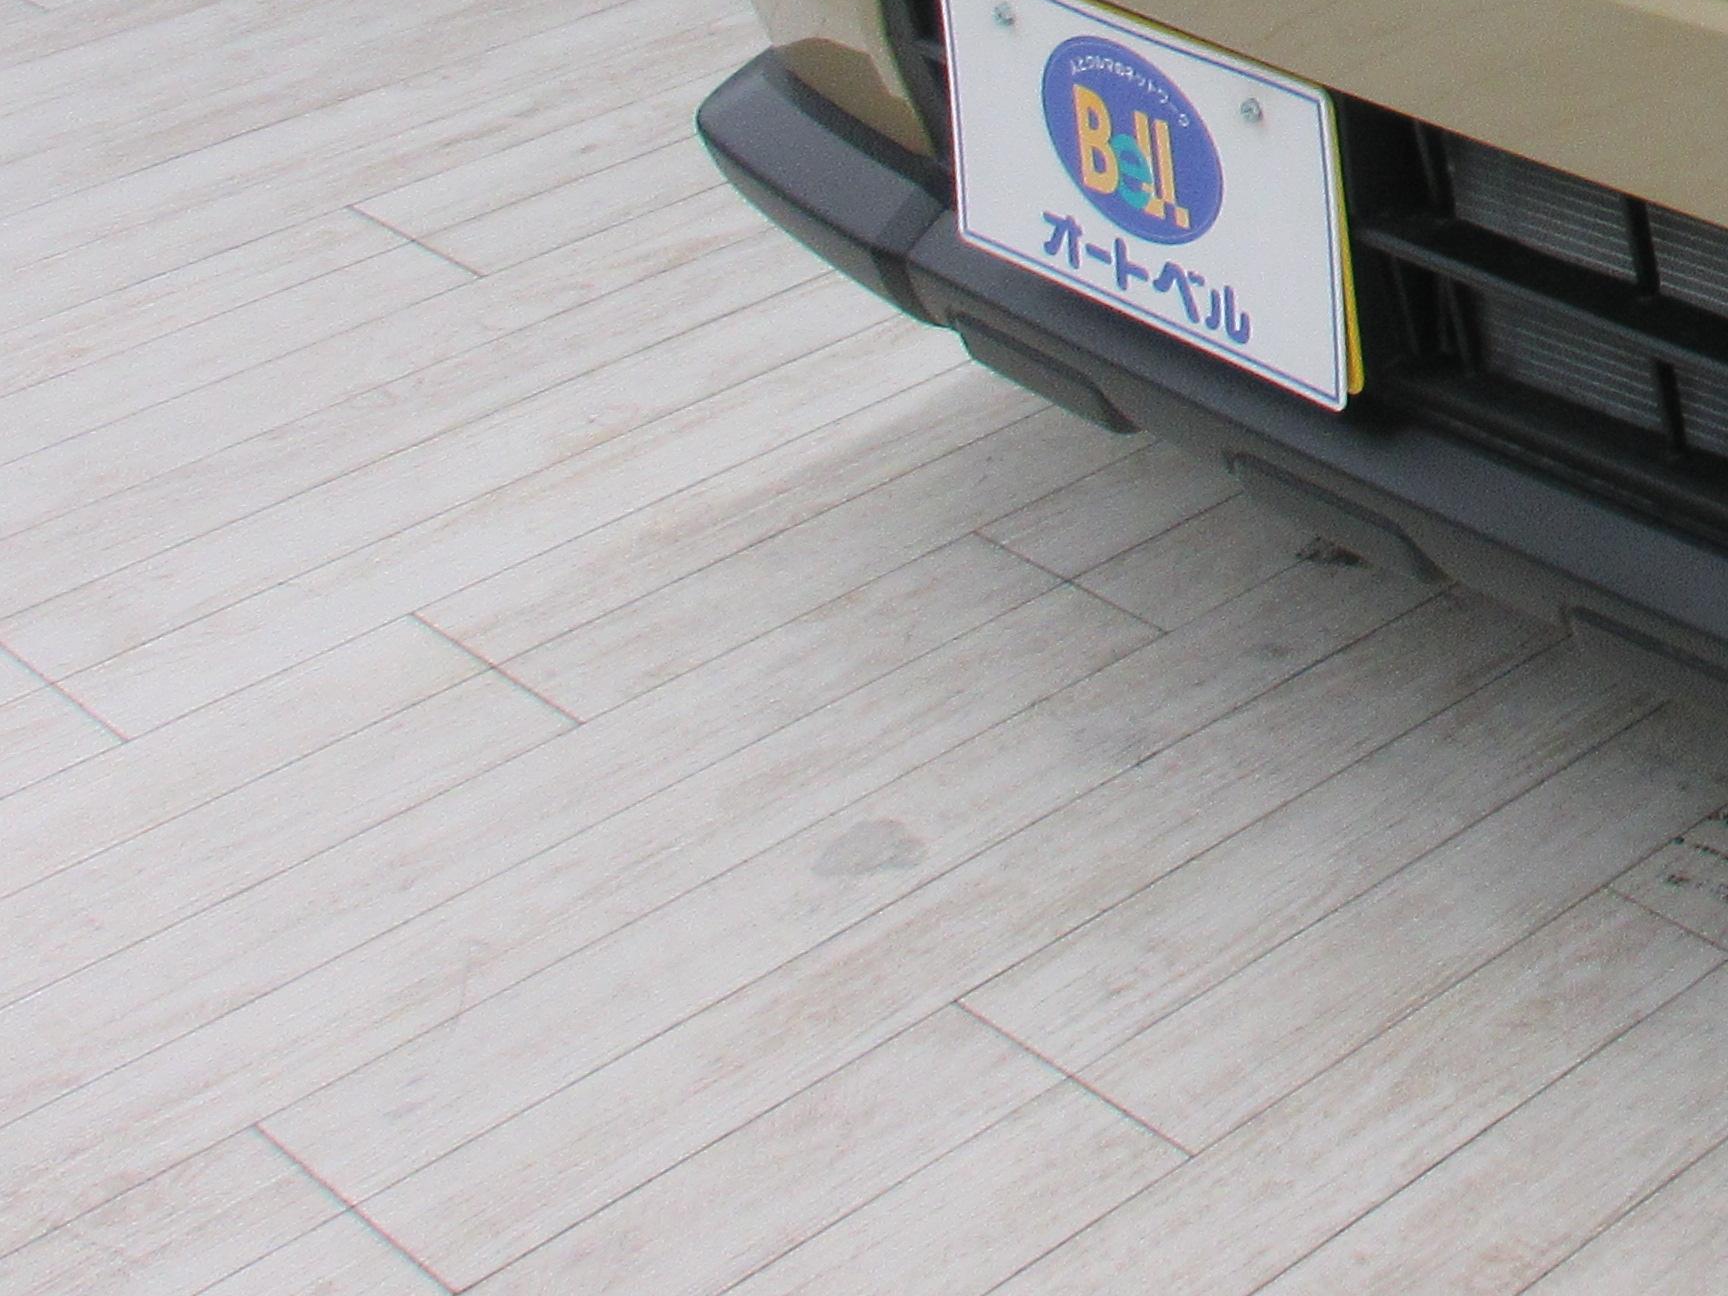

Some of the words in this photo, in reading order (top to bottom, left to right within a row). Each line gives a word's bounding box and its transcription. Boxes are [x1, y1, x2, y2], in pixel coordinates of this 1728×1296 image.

[1043, 209, 1251, 345] オートベル
